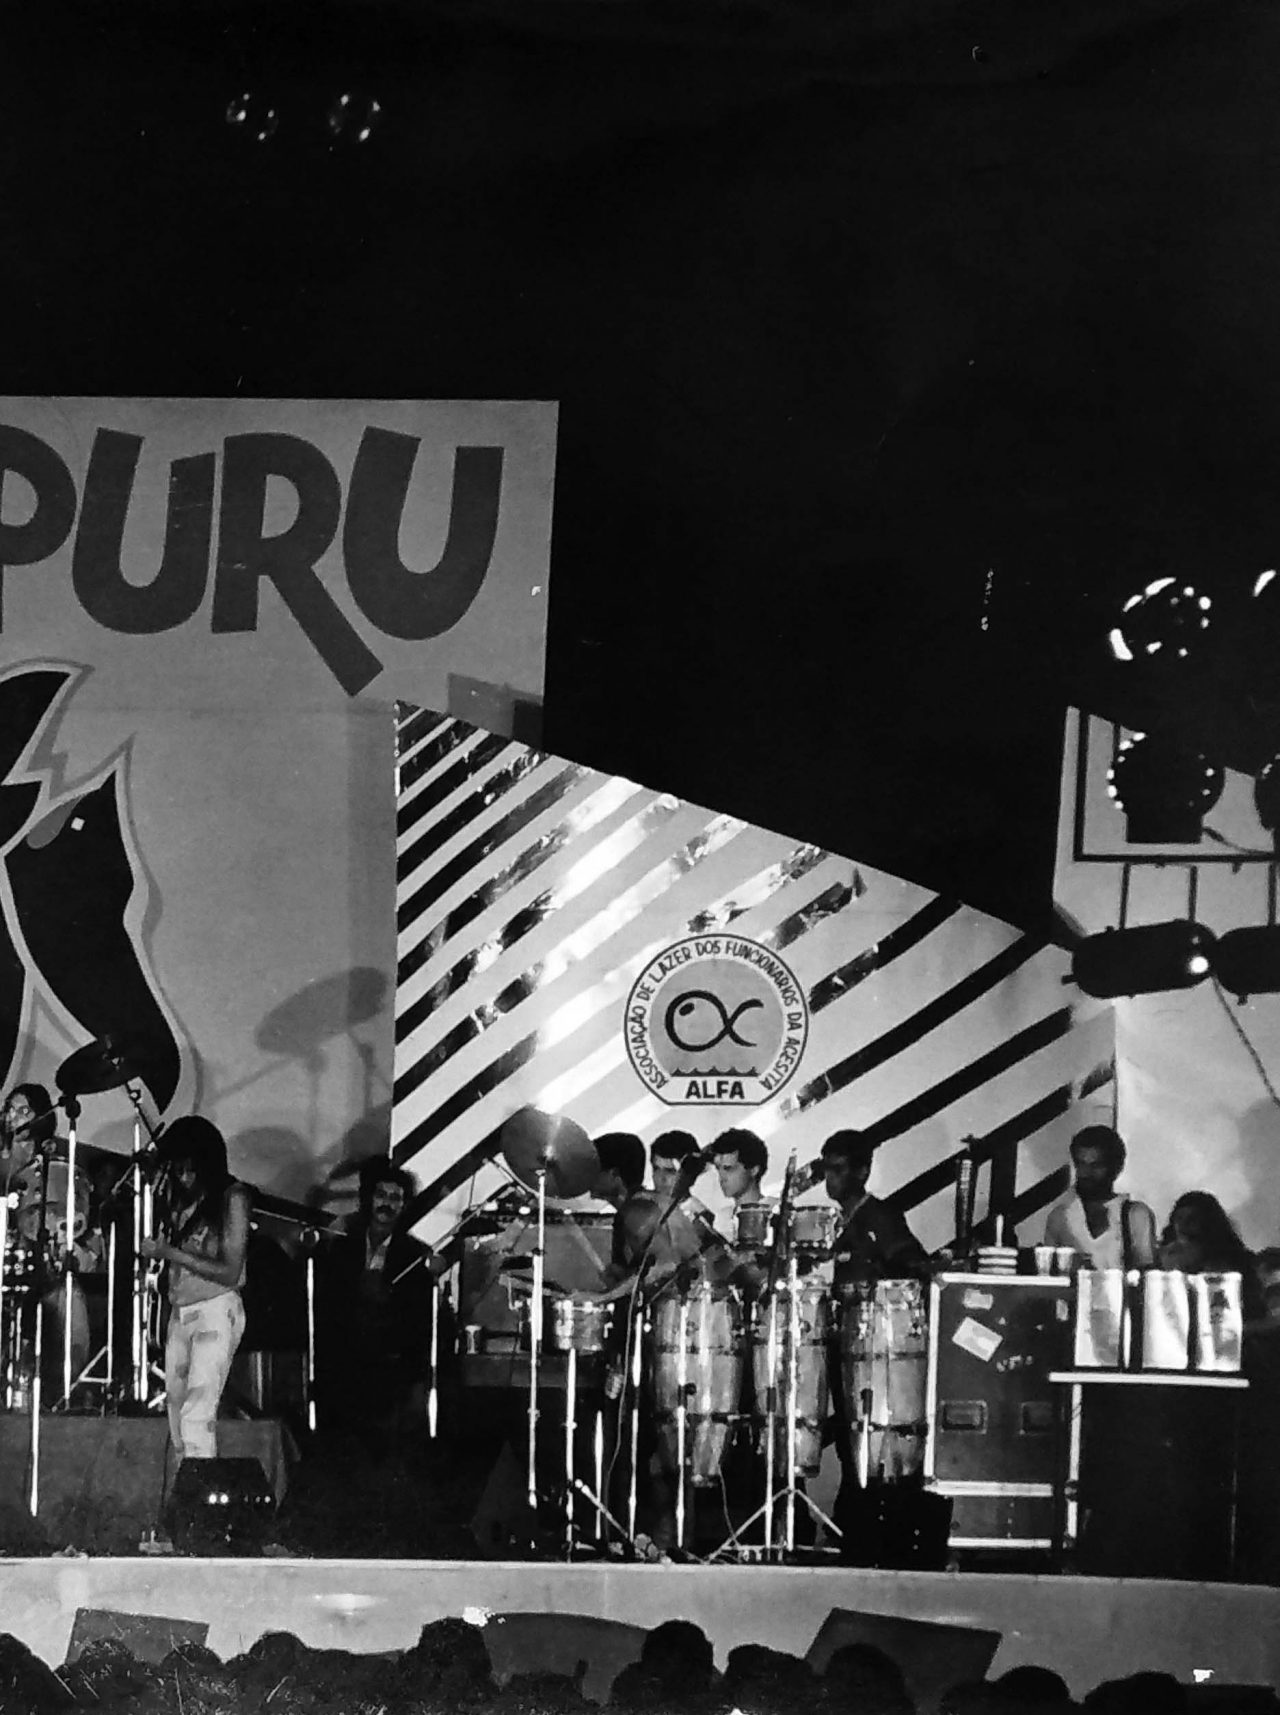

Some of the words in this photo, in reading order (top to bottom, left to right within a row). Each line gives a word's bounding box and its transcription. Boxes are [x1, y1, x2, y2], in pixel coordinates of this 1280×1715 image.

[695, 940, 721, 957] DOS
[649, 946, 692, 983] LAZER
[636, 982, 655, 1001] DE
[787, 1011, 803, 1031] DA
[759, 1037, 801, 1091] ACESITA
[685, 1080, 745, 1099] ALFA
